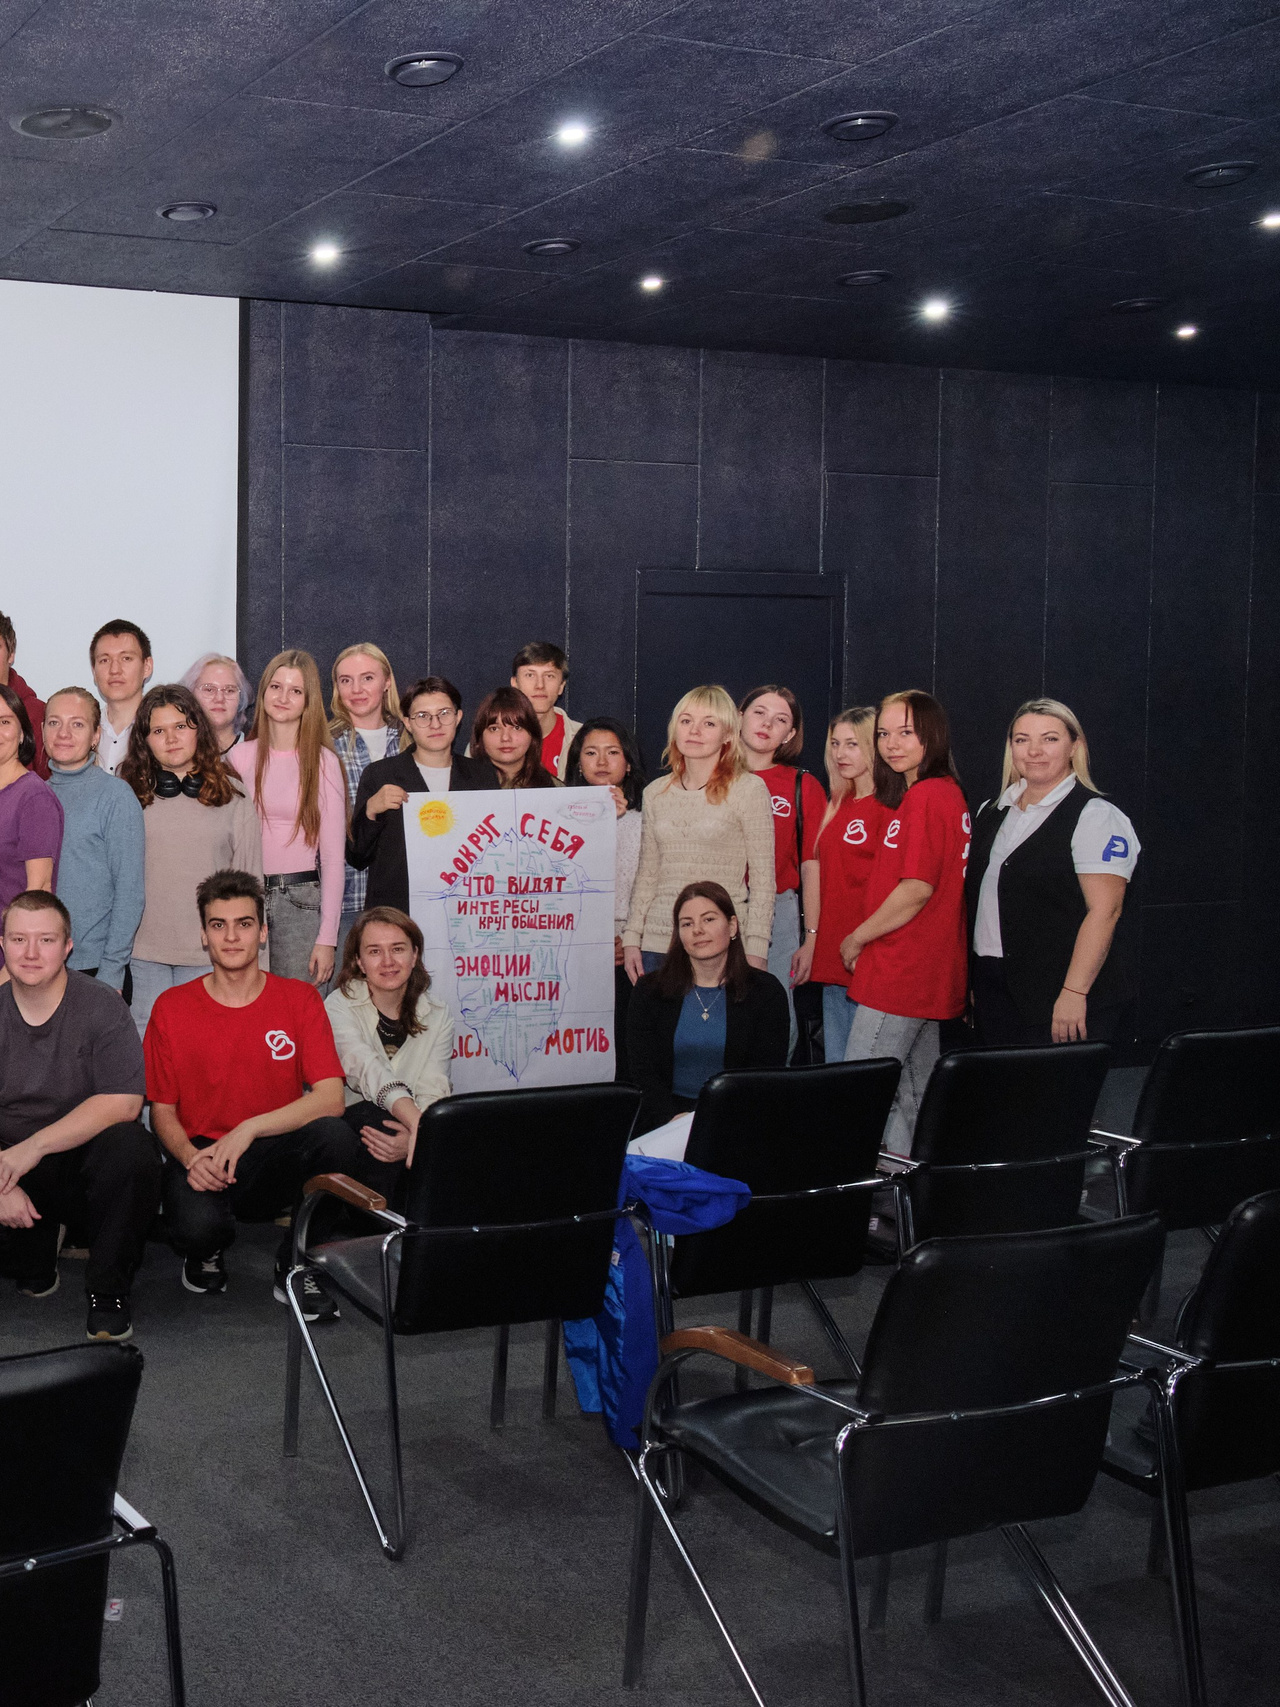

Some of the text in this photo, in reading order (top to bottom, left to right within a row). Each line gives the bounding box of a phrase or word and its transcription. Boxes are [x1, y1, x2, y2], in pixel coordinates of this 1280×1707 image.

[440, 813, 585, 886] ВОКРУГ СЕБЯ
[463, 875, 566, 897] ЧТО ВИДЯТ
[457, 900, 539, 915] ИНТЕРЕСЫ
[479, 913, 574, 931] КРУГ ОБЩЕНИЯ
[454, 954, 531, 979] ЭМОЦИИ
[494, 981, 560, 1002] МЫСЛИ
[545, 1027, 610, 1055] МОТИВ
